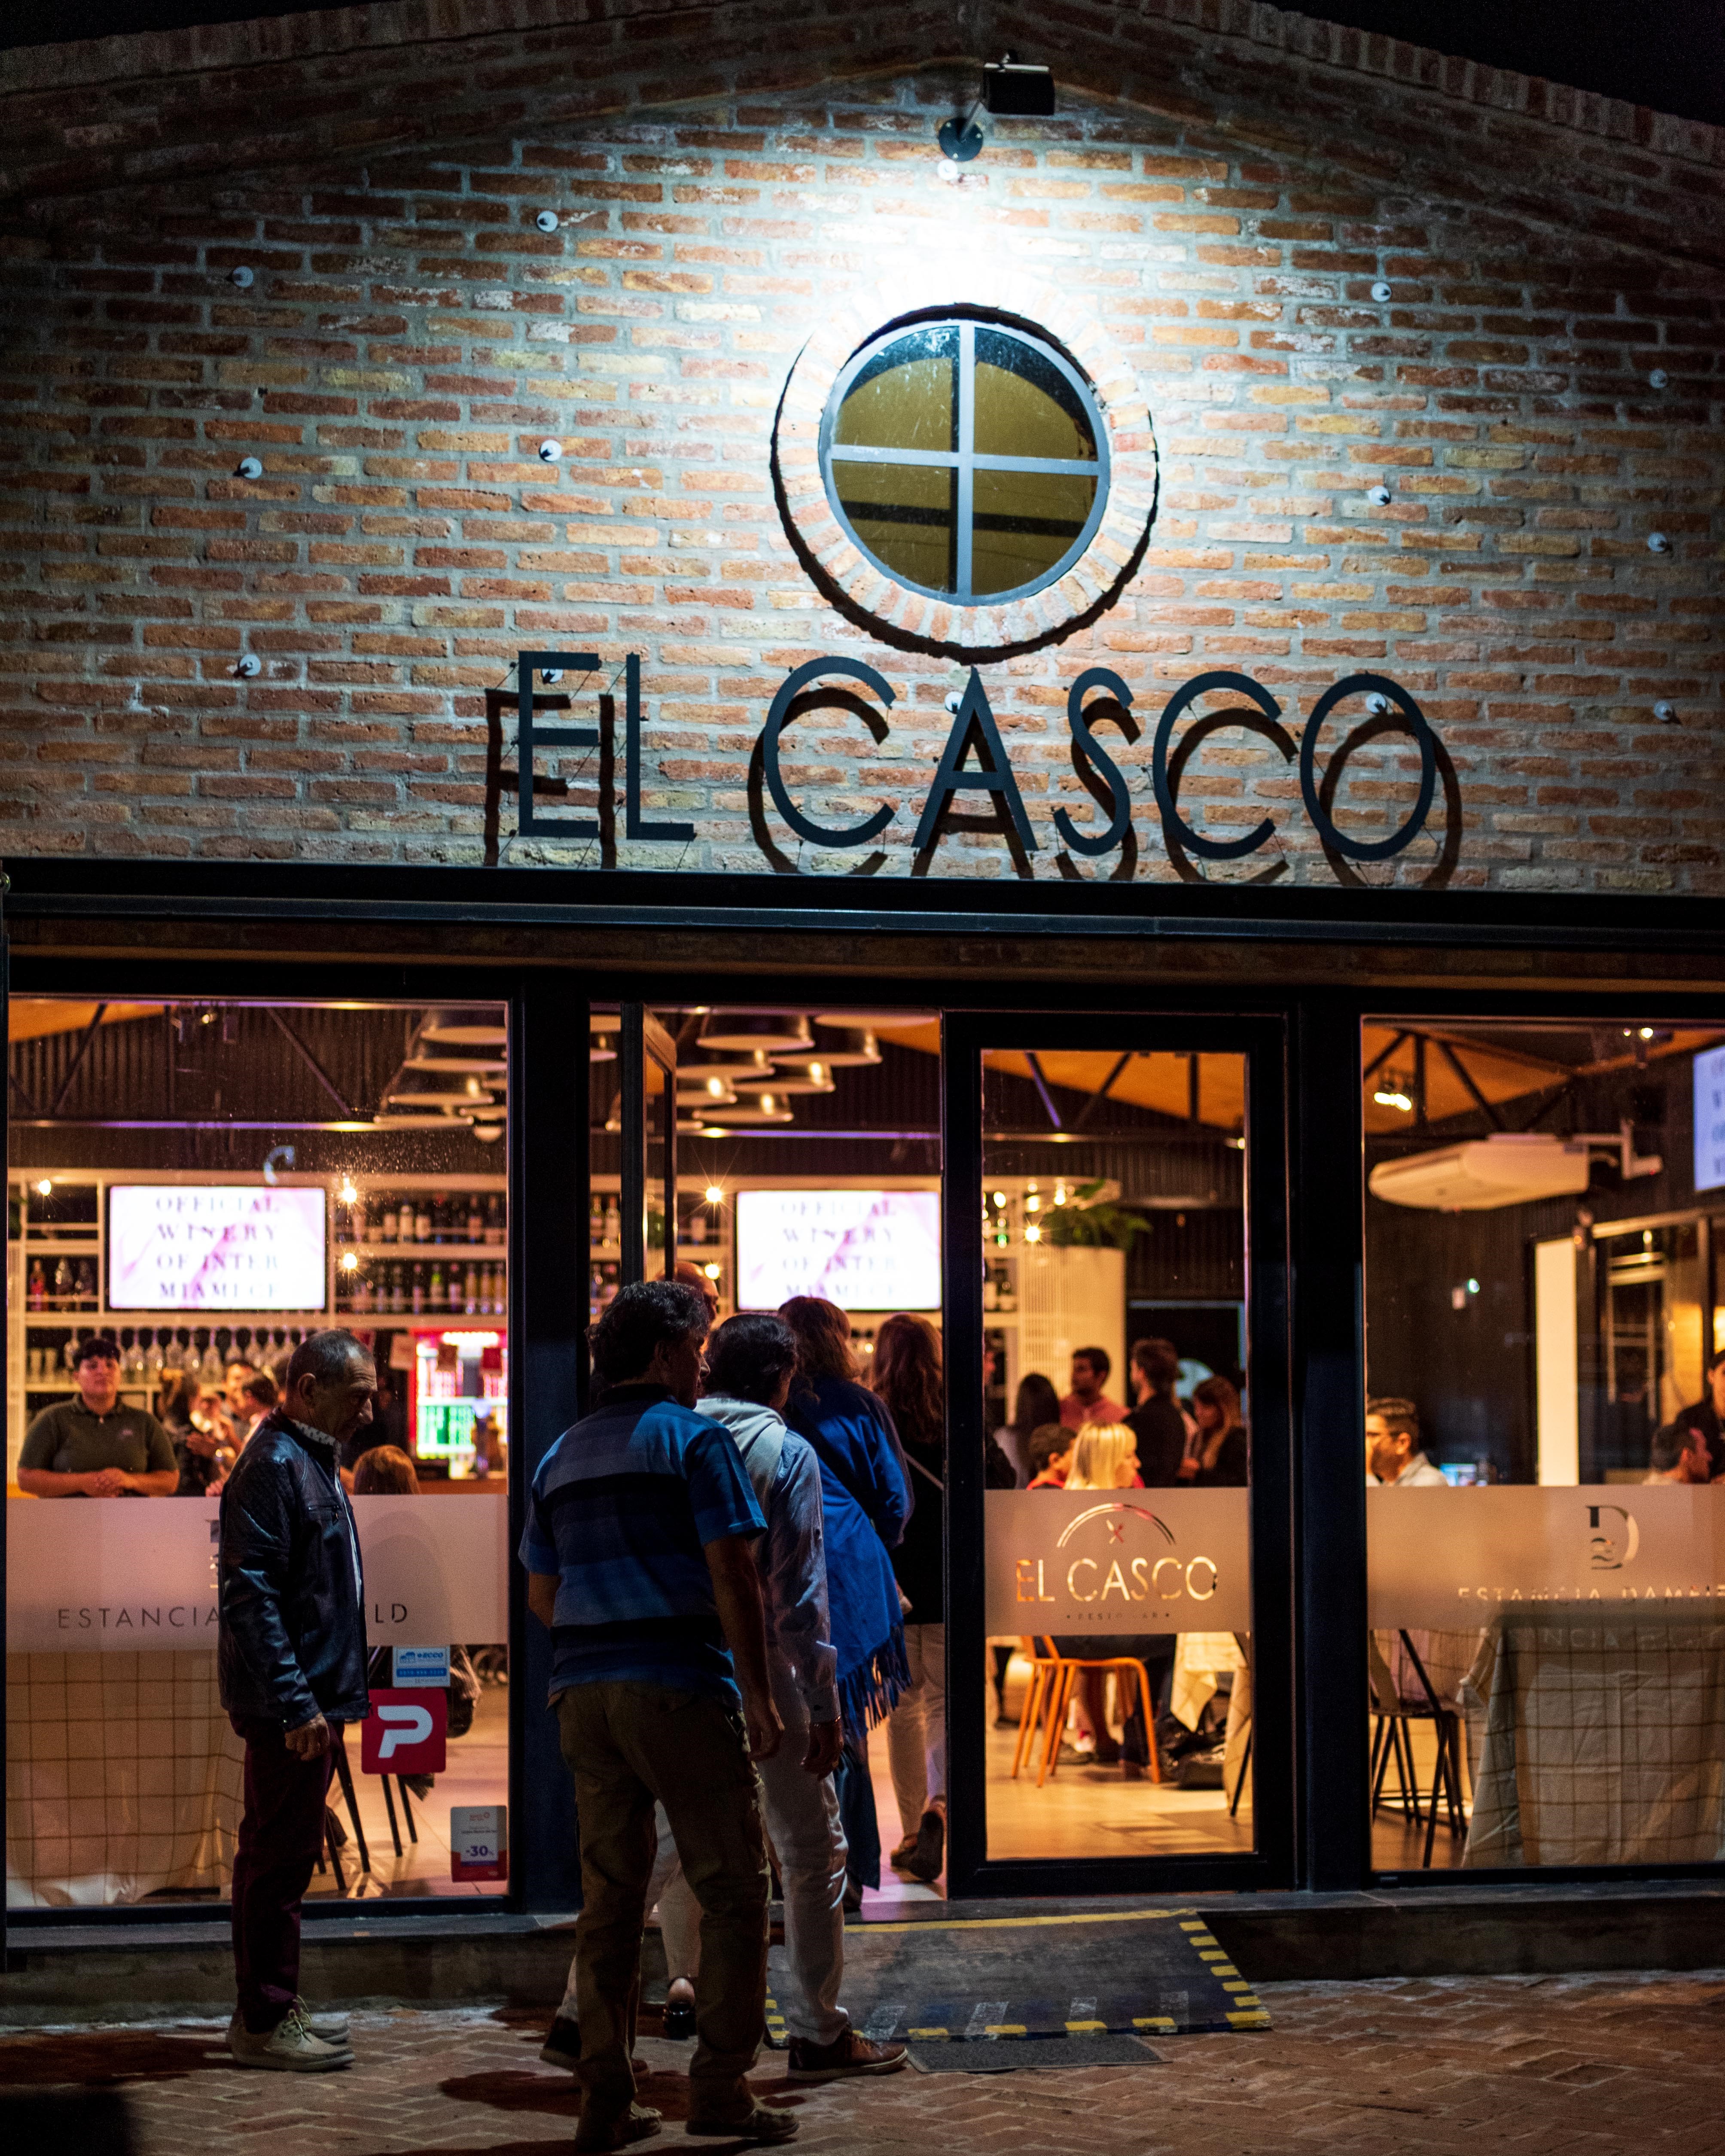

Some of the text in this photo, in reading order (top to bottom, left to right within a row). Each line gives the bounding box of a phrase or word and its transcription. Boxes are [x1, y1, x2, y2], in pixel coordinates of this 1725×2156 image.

[519, 651, 1435, 859] EL CASCO
[156, 1195, 279, 1213] OFFICIAL
[157, 1223, 277, 1241] WINERY
[783, 1227, 893, 1244] WINERY
[156, 1252, 278, 1271] OF INTER
[159, 1282, 238, 1299] MIAMI
[1016, 1556, 1218, 1602] EL CASCO
[58, 1607, 219, 1629] ESTANCIA
